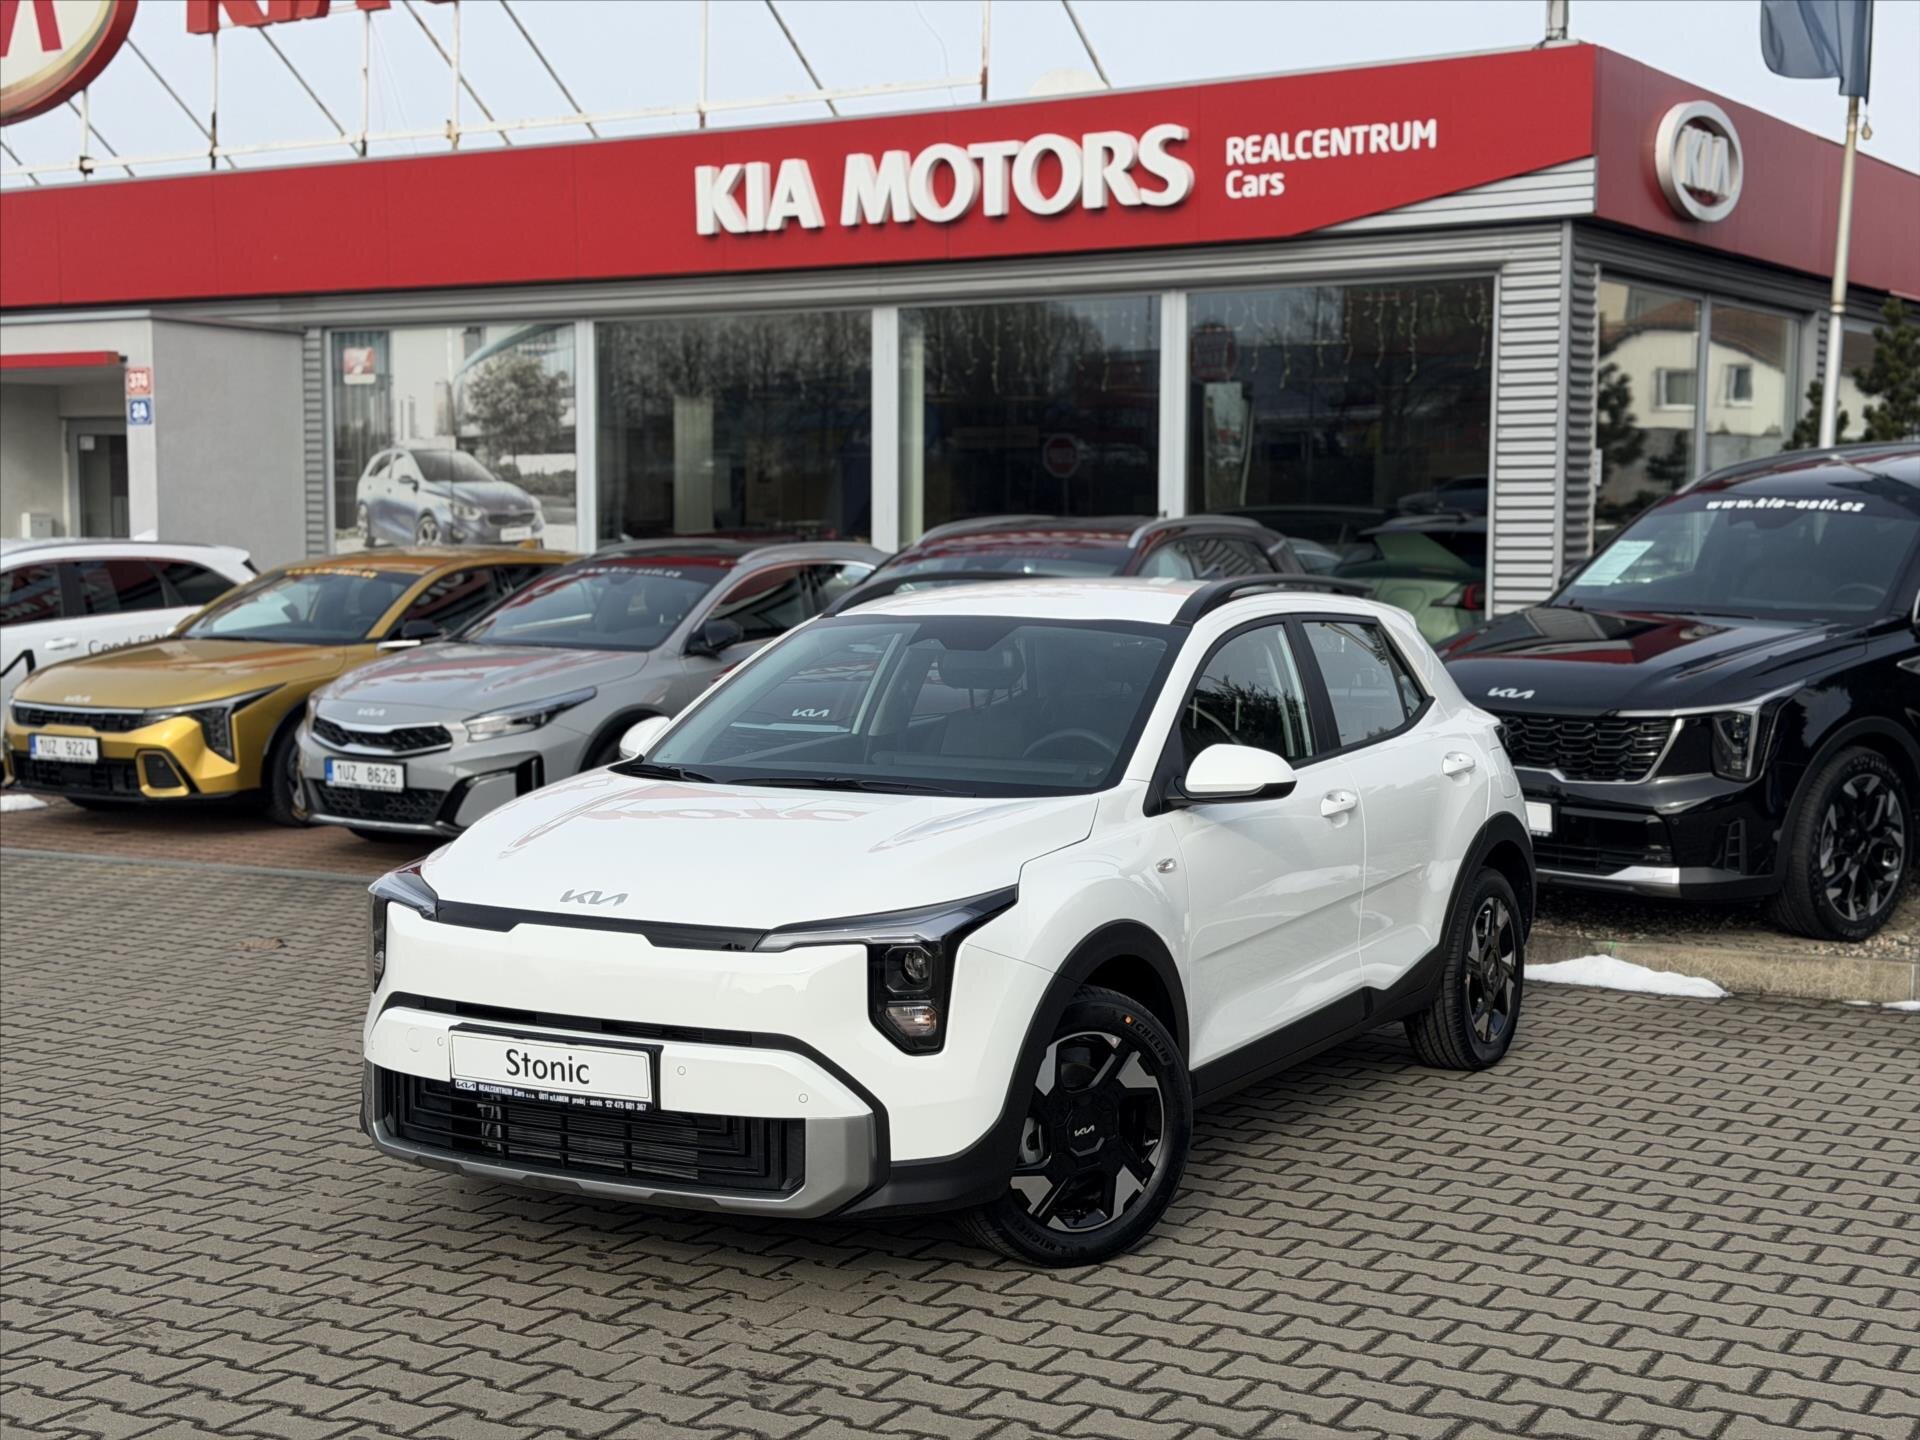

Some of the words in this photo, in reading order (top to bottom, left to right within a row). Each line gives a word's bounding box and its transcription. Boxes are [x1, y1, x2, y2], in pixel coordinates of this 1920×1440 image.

[1225, 118, 1437, 166] REALCENTRUM
[1676, 124, 1731, 197] KIA
[694, 158, 826, 236] KIA
[840, 123, 1195, 227] MOTORS
[1225, 169, 1285, 199] Cars
[1487, 687, 1536, 699] KIA
[791, 708, 830, 718] KIA
[39, 739, 58, 755] 1UZ
[65, 740, 92, 757] 9224
[336, 763, 358, 782] 1UZ
[366, 765, 398, 785] 8628
[559, 889, 629, 906] KIA
[505, 1048, 590, 1085] Stonic
[478, 1083, 513, 1096] REALCENTRUM
[513, 1088, 525, 1098] Cars
[614, 1100, 625, 1110] 475
[1074, 1124, 1096, 1137] KIA
